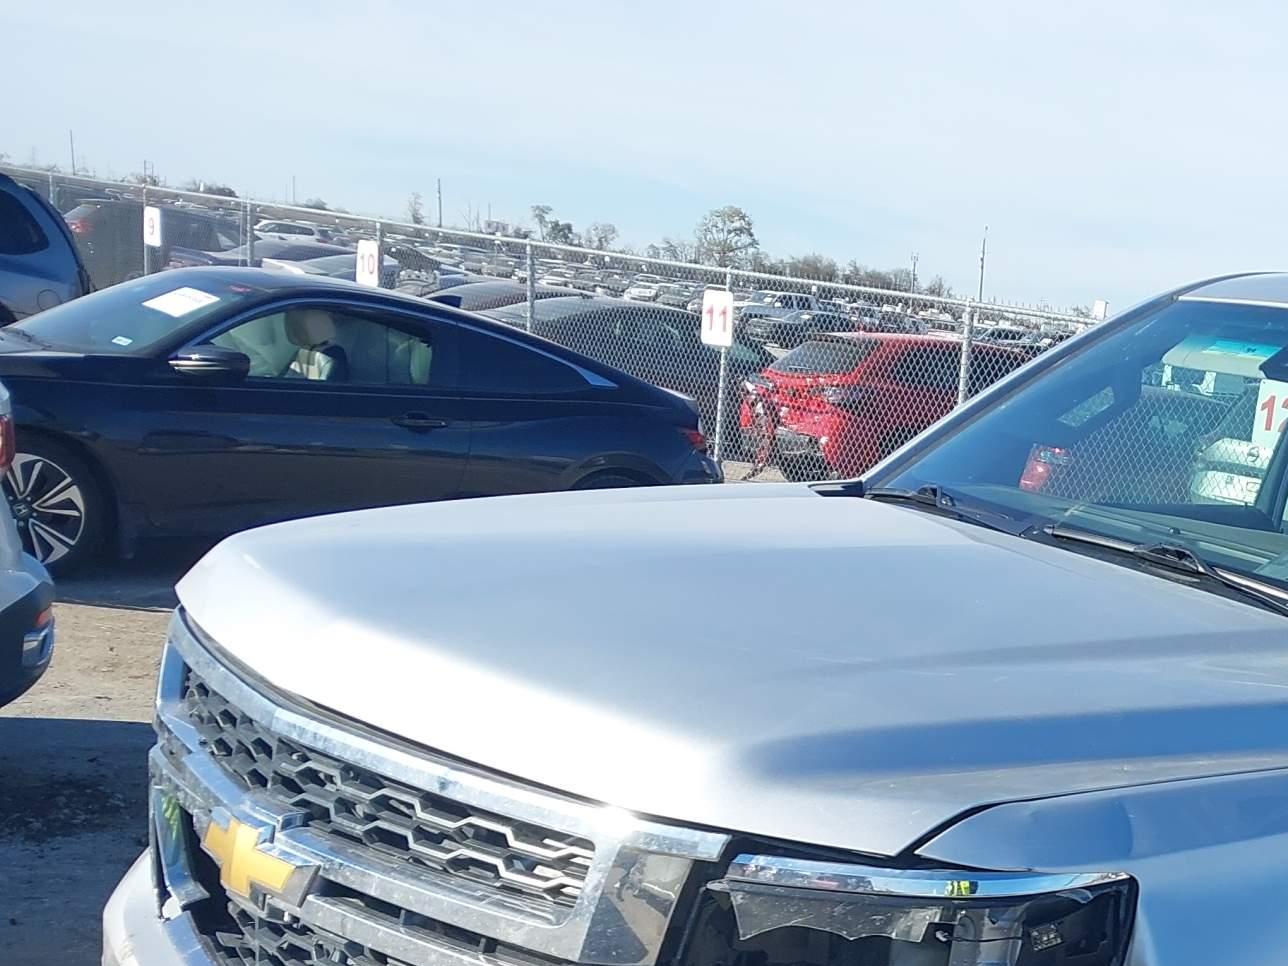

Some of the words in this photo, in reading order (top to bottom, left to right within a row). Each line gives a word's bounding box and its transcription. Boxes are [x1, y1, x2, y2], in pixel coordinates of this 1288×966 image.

[148, 217, 155, 235] 9
[360, 254, 375, 274] 10
[705, 304, 727, 332] 11
